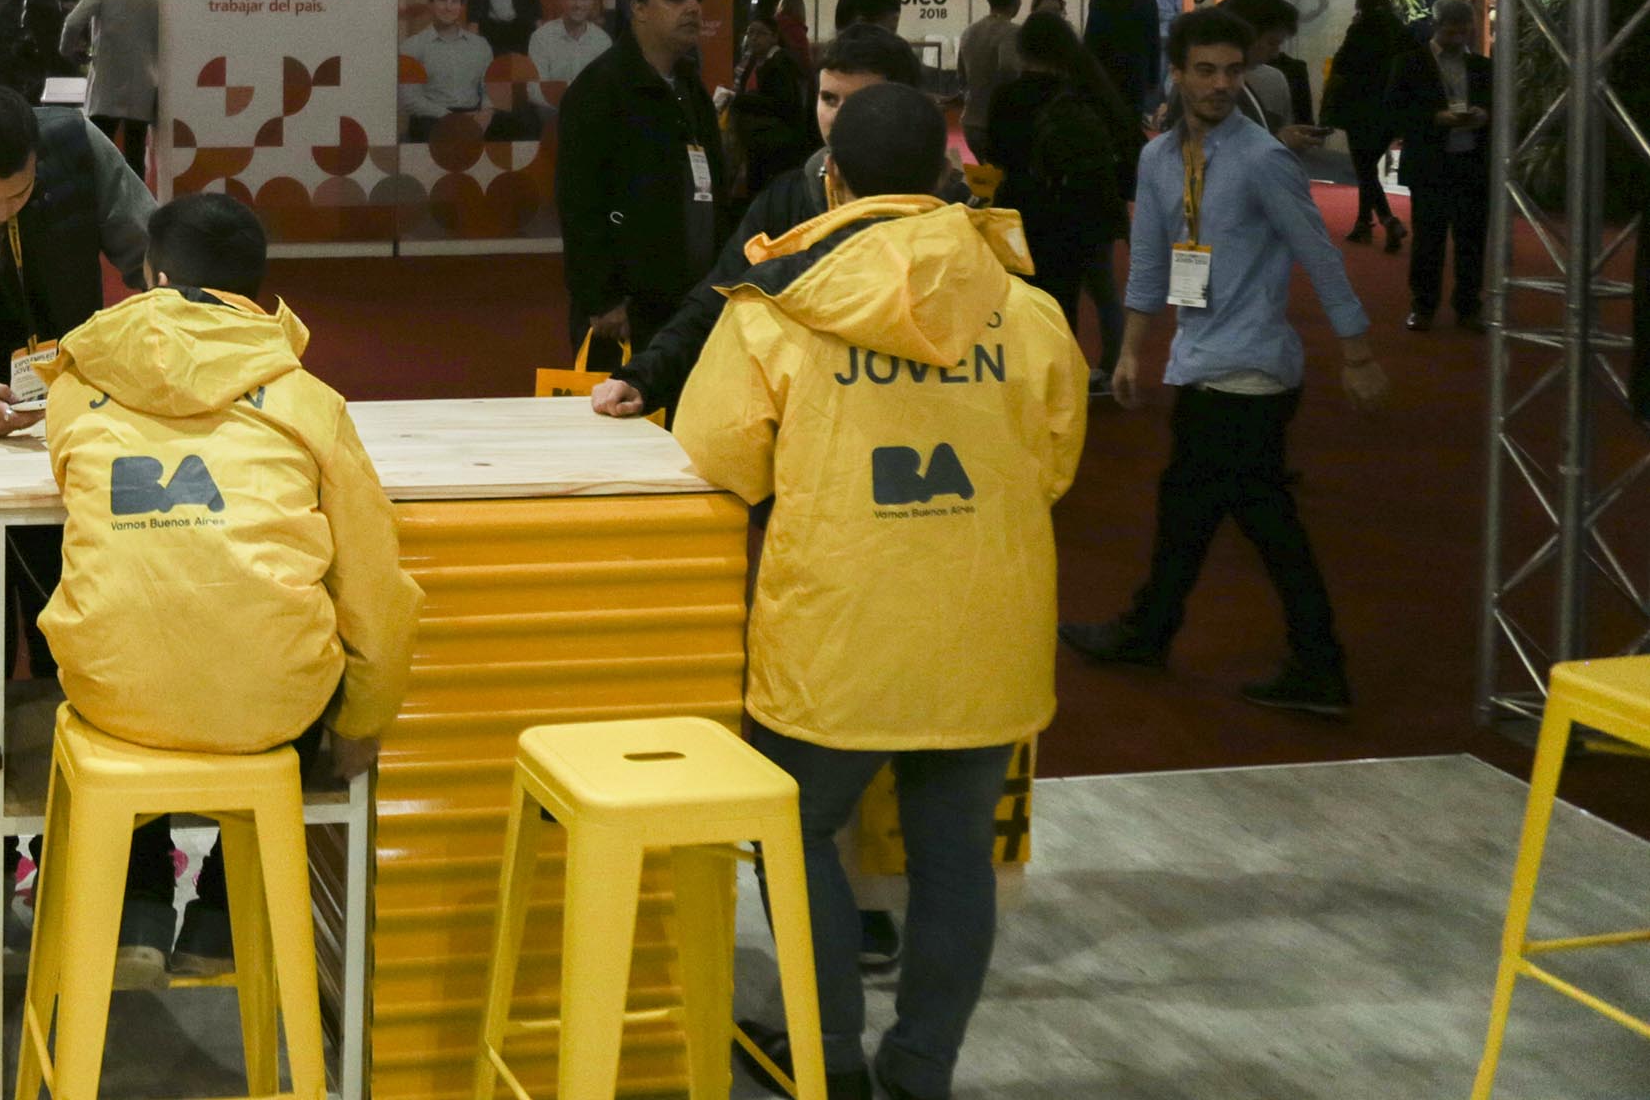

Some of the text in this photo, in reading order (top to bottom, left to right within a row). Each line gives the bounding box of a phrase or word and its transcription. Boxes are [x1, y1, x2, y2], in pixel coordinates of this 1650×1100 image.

[919, 8, 948, 20] 2018
[872, 442, 976, 505] BA
[110, 454, 226, 516] BA
[874, 509, 909, 520] Vamos
[911, 508, 948, 518] Buenos
[111, 516, 226, 531] Vamos Buenos Aires
